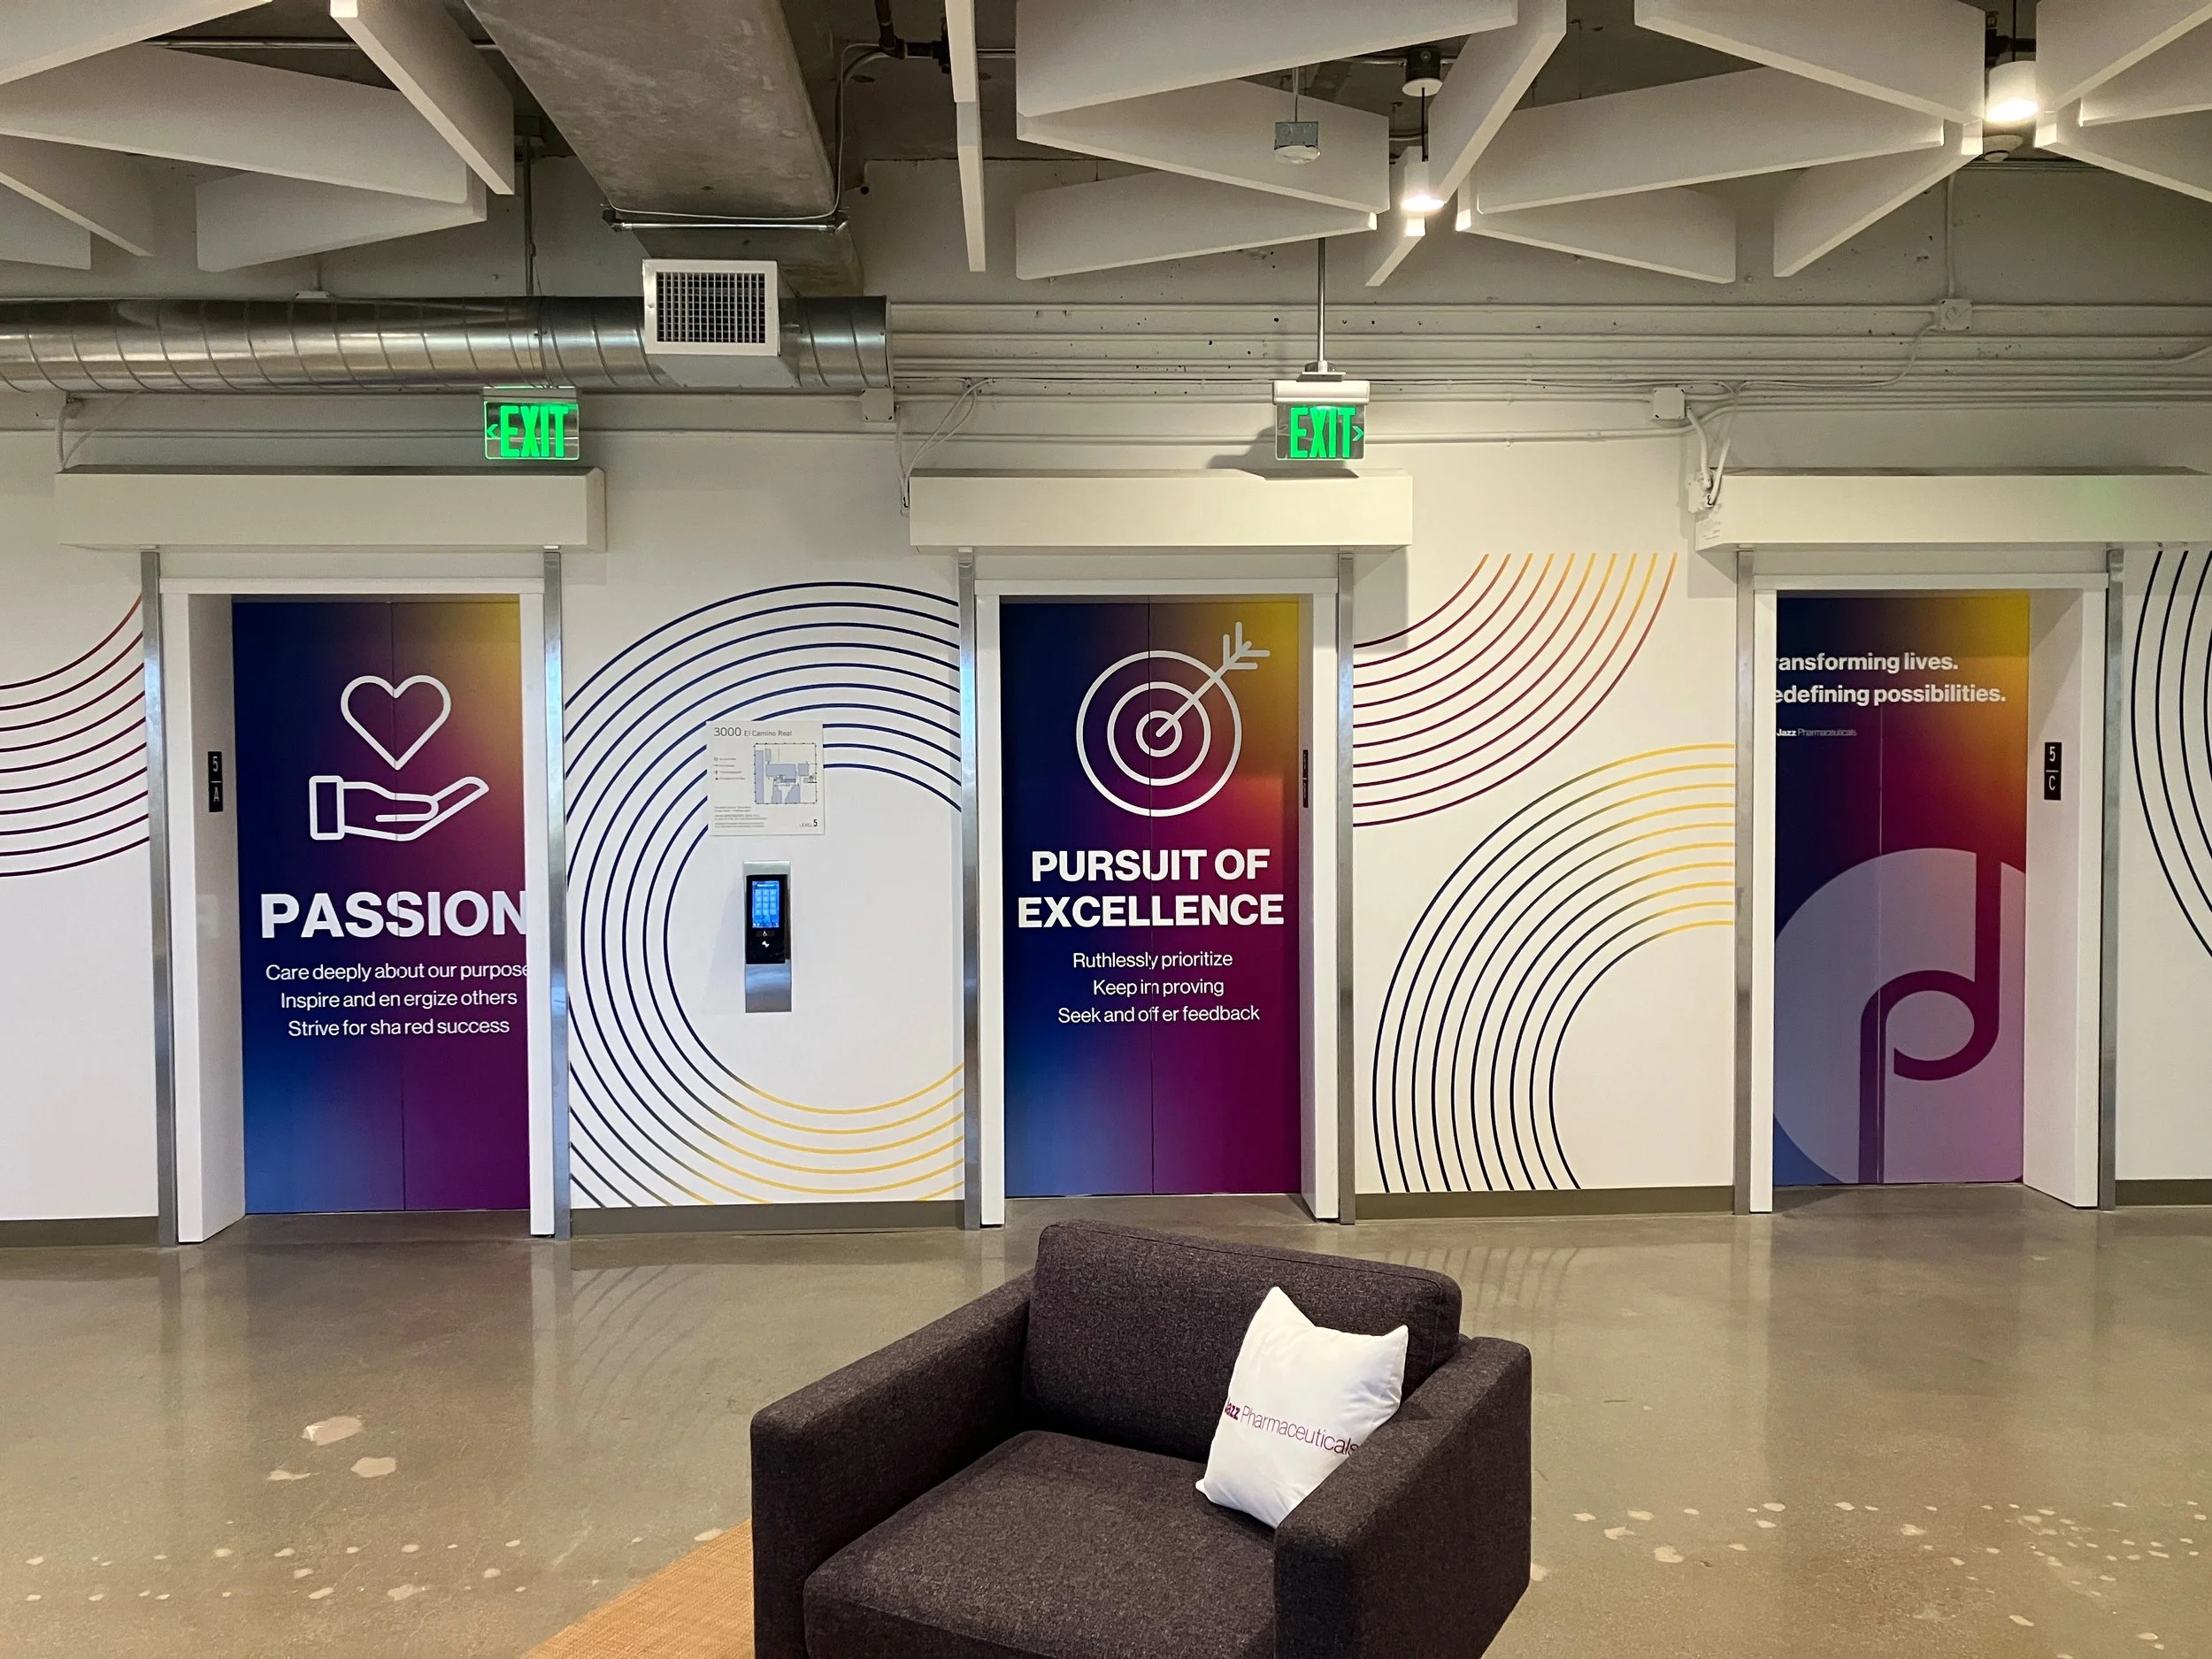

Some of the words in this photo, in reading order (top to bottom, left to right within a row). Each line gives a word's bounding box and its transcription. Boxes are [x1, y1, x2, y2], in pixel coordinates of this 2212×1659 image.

[501, 405, 569, 457] EXIT
[1290, 407, 1356, 458] EXIT
[1776, 652, 1900, 674] ansforming
[1904, 652, 1959, 671] lives.
[1776, 685, 1870, 706] edefining
[1874, 684, 2006, 706] possibilities.
[713, 726, 741, 737] 3000
[1777, 728, 1797, 737] Jazz
[212, 756, 219, 772] 5
[2049, 746, 2055, 762] 5
[2049, 775, 2055, 790] C
[213, 787, 219, 802] A
[813, 818, 818, 827] 5
[1032, 849, 1207, 882] PURSUIT
[1215, 849, 1271, 880] OF
[261, 890, 526, 939] PASSION
[1018, 894, 1285, 928] EXCELLENCE
[1072, 952, 1158, 971] Ruthlessly
[1162, 951, 1233, 970] prioritize
[265, 964, 310, 980] Care
[312, 963, 372, 983] deeply
[374, 962, 425, 979] about
[428, 965, 457, 979] our
[1094, 979, 1138, 998] Keep
[281, 992, 340, 1011] Inspire
[343, 991, 376, 1008] and
[460, 989, 518, 1006] others
[1058, 1007, 1102, 1024] Seek
[1104, 1007, 1135, 1023] and
[1182, 1004, 1260, 1022] feedback
[288, 1019, 340, 1037] Strive
[342, 1019, 368, 1036] for
[437, 1020, 511, 1034] success
